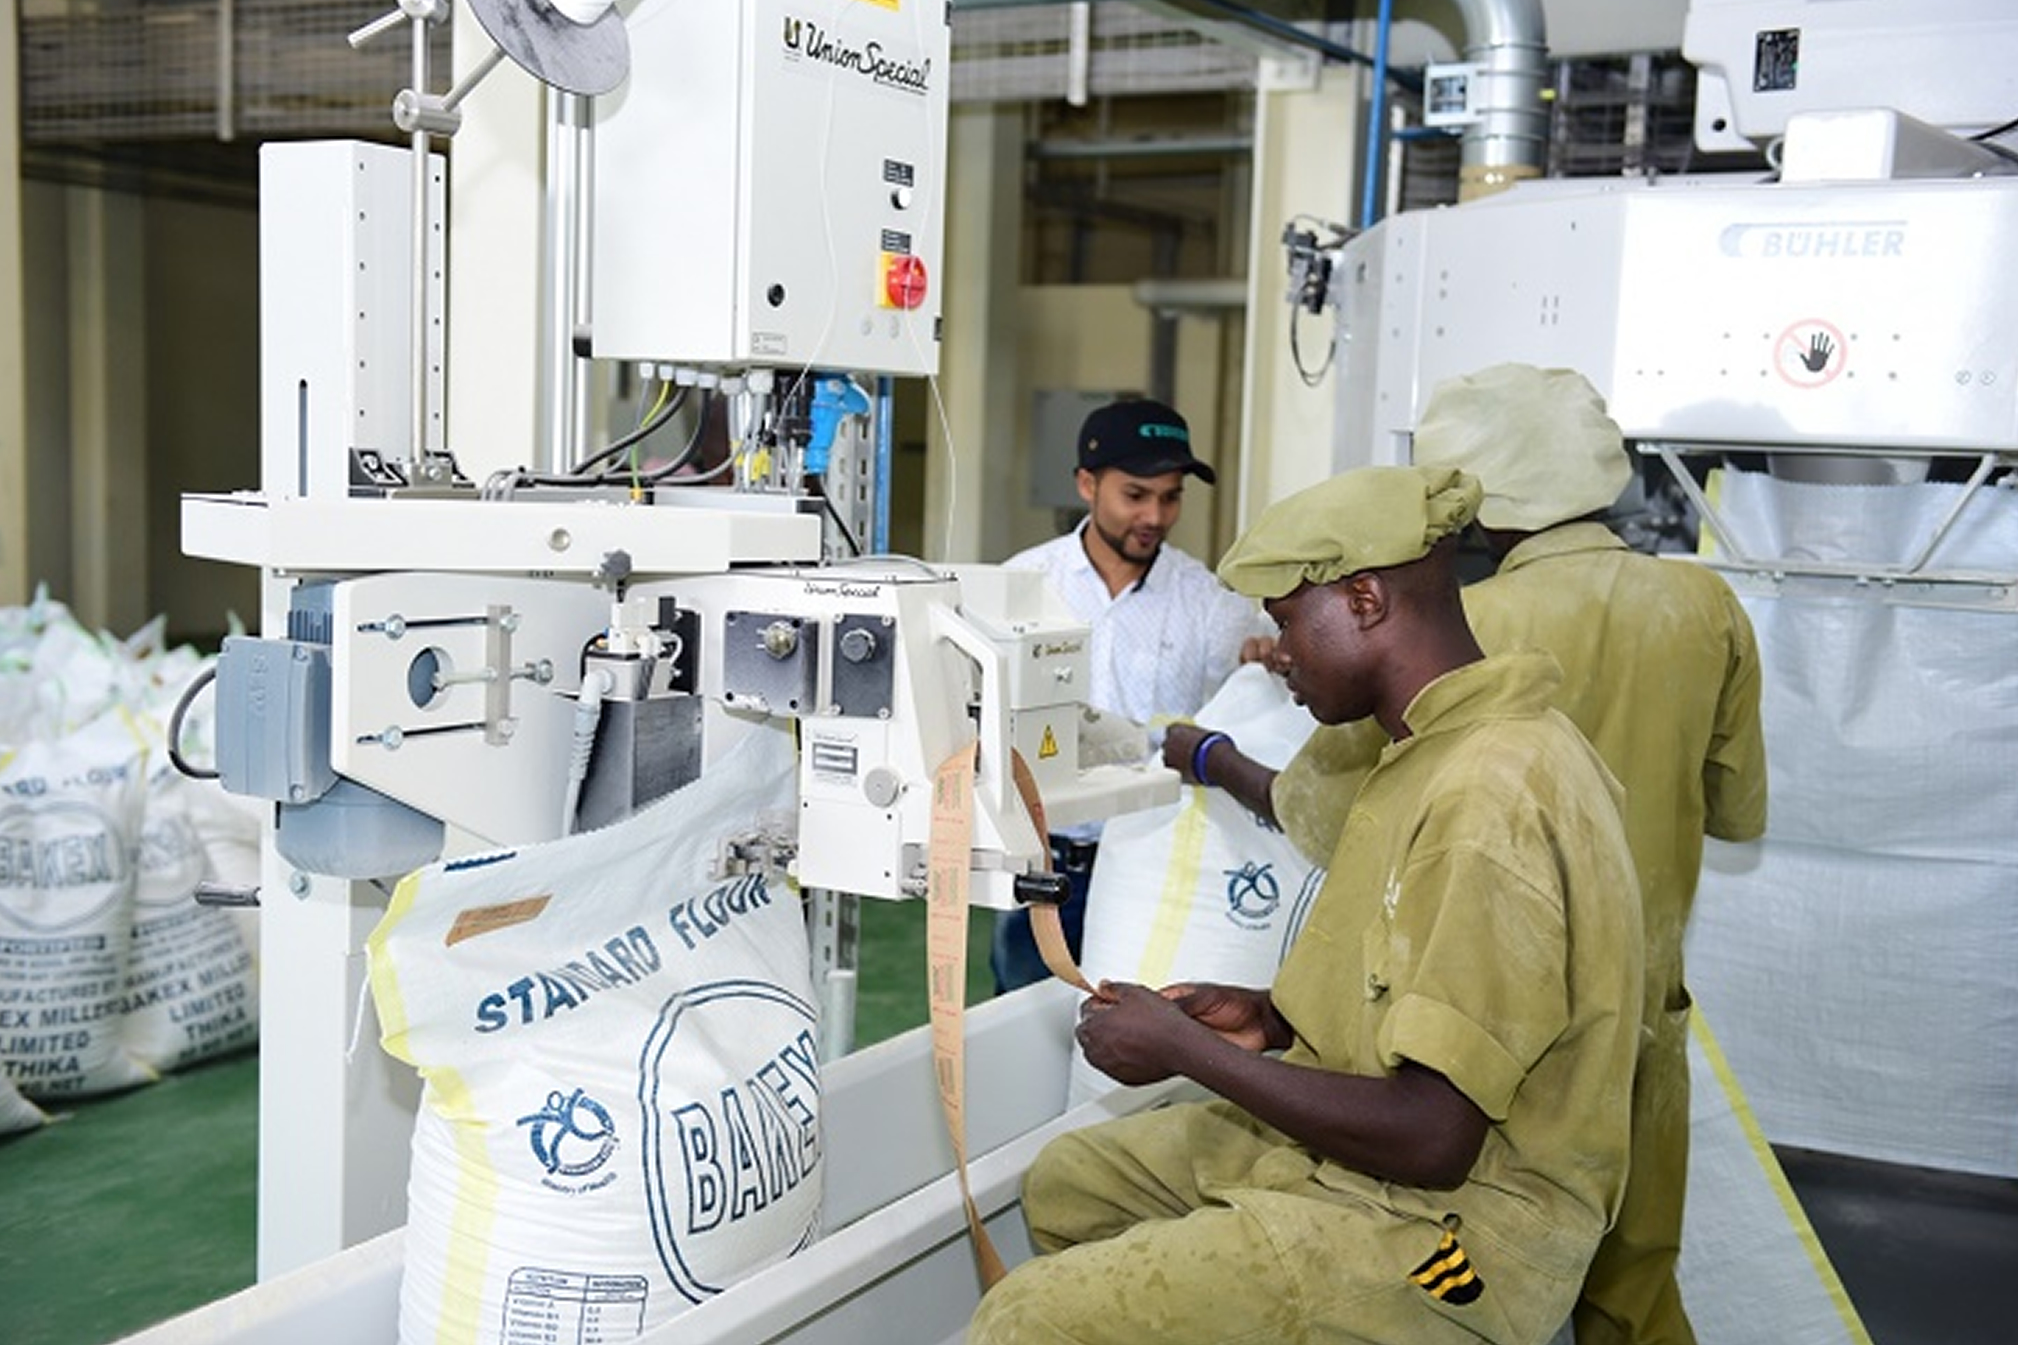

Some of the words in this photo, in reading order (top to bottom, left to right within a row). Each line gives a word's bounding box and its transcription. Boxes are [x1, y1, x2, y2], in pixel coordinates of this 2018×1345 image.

[1762, 231, 1905, 257] BÜHLER
[475, 925, 662, 1033] STANDARD
[669, 873, 771, 949] FLOUR
[4, 1056, 80, 1077] THIKA
